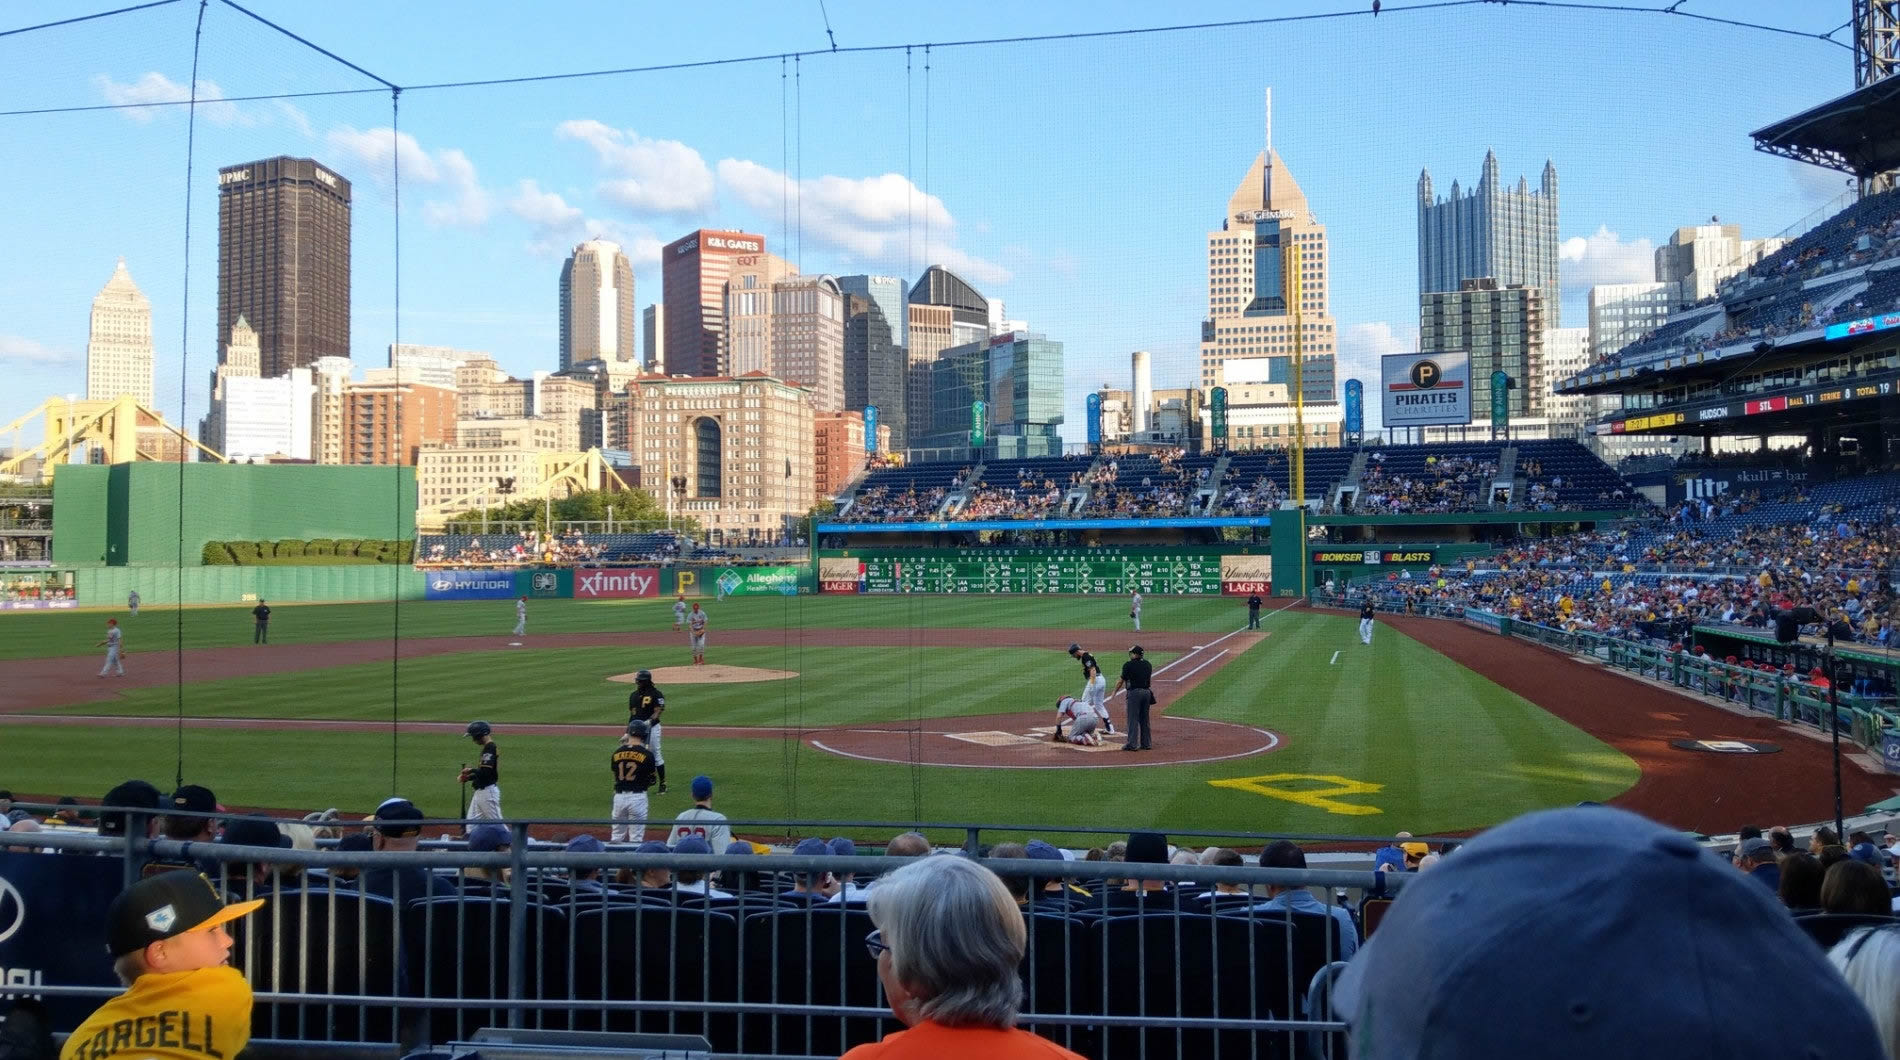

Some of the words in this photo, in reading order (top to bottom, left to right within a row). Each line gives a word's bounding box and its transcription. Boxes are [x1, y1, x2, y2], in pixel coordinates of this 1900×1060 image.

[218, 169, 250, 185] UPMC
[315, 167, 337, 188] UPMC
[708, 237, 726, 248] K&L
[727, 240, 759, 252] GATES
[737, 256, 758, 266] EQT
[1419, 366, 1433, 384] P
[1396, 392, 1457, 406] PIRATES
[1700, 406, 1728, 420] HUDSON
[1759, 402, 1772, 412] STL
[1789, 397, 1804, 406] BALL
[1805, 394, 1814, 404] 11
[1820, 391, 1841, 402] STRIKE
[1844, 388, 1850, 399] 8
[1856, 386, 1878, 396] TOTAL
[1879, 382, 1890, 394] 19
[1395, 404, 1458, 416] CHARITIES
[1737, 470, 1768, 482] skull
[1786, 470, 1808, 481] bar
[1321, 553, 1363, 562] BOWSER
[1392, 552, 1431, 562] BLASTS
[746, 574, 797, 584] Allegheny
[820, 566, 858, 579] Yuengling
[1223, 566, 1270, 580] Yuengling
[455, 580, 509, 590] HYUNDAI
[580, 572, 653, 596] xfinity
[678, 570, 696, 594] P
[824, 582, 853, 591] LAGER
[1228, 582, 1265, 592] LAGER
[618, 761, 638, 781] 12
